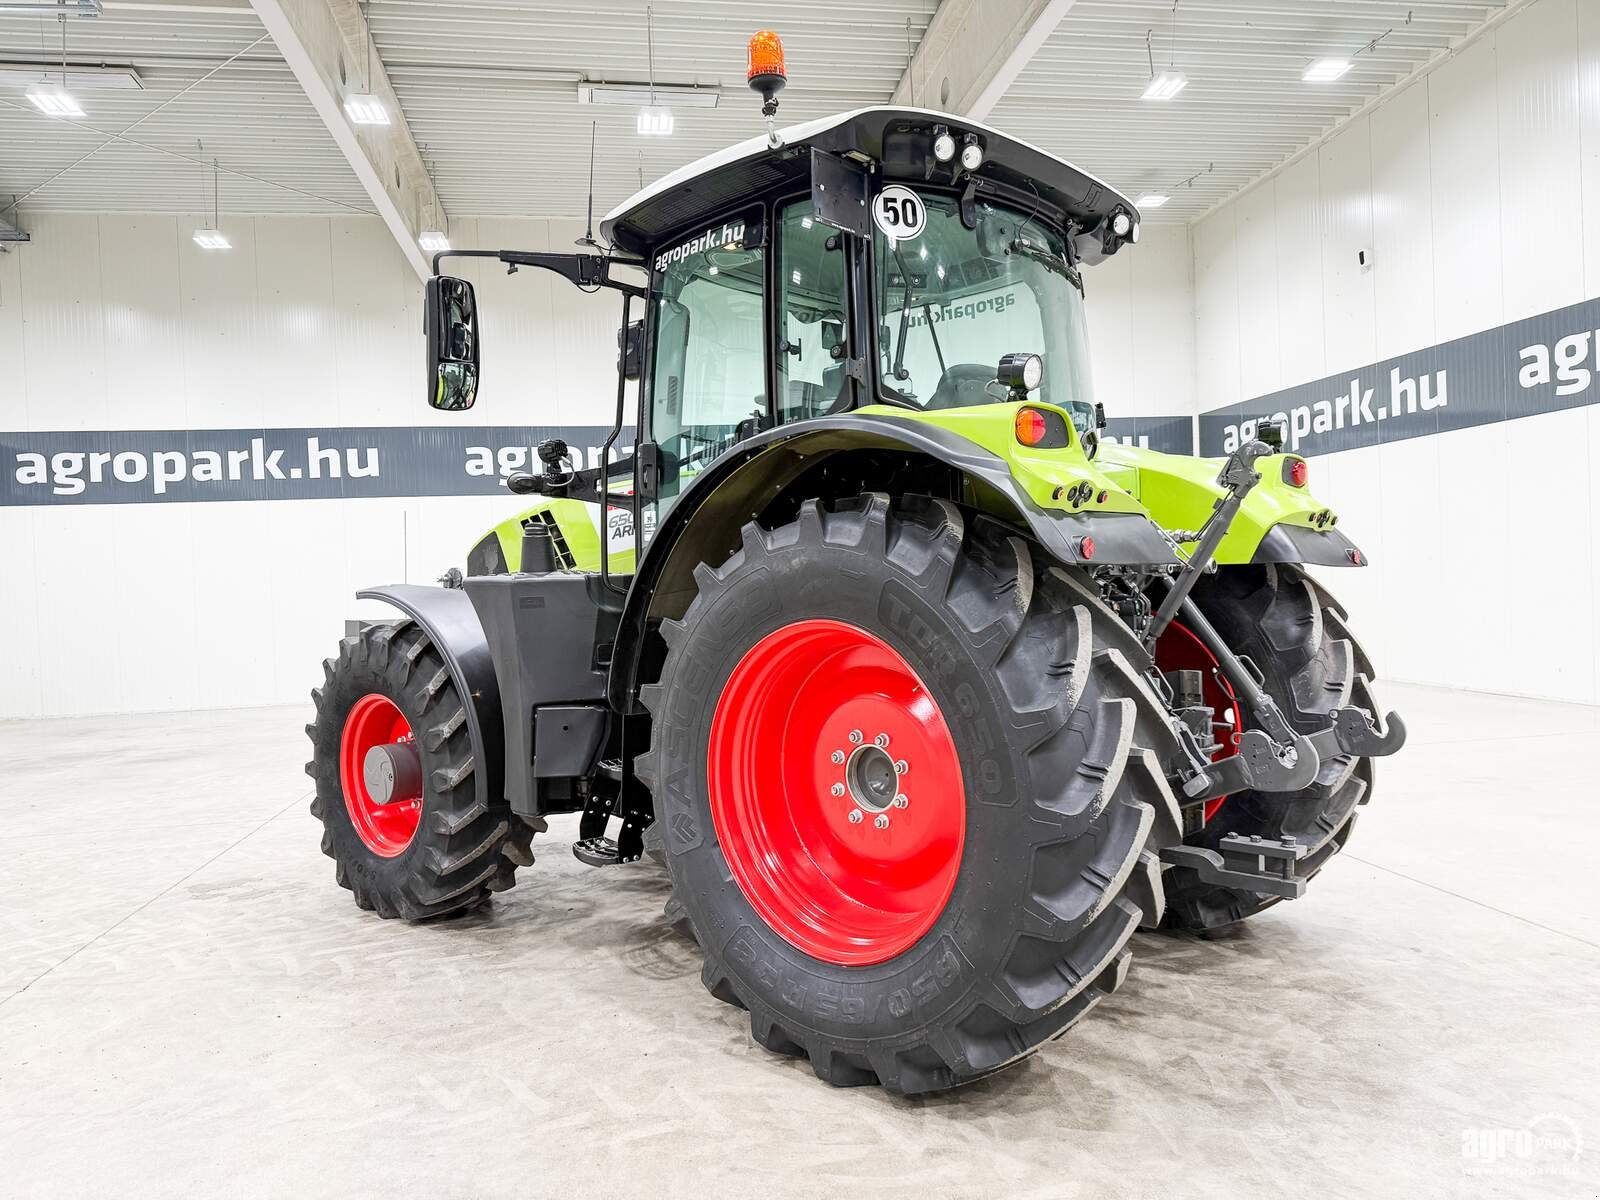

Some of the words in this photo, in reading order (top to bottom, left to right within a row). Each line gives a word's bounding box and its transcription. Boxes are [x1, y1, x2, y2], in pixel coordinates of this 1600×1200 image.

[883, 197, 918, 228] 50
[655, 224, 745, 272] agropark.hu
[1519, 329, 1600, 395] ag
[1223, 368, 1448, 454] agopark.hu
[15, 437, 380, 495] agropark.hu
[612, 524, 635, 540] ARI
[953, 681, 1003, 795] 650
